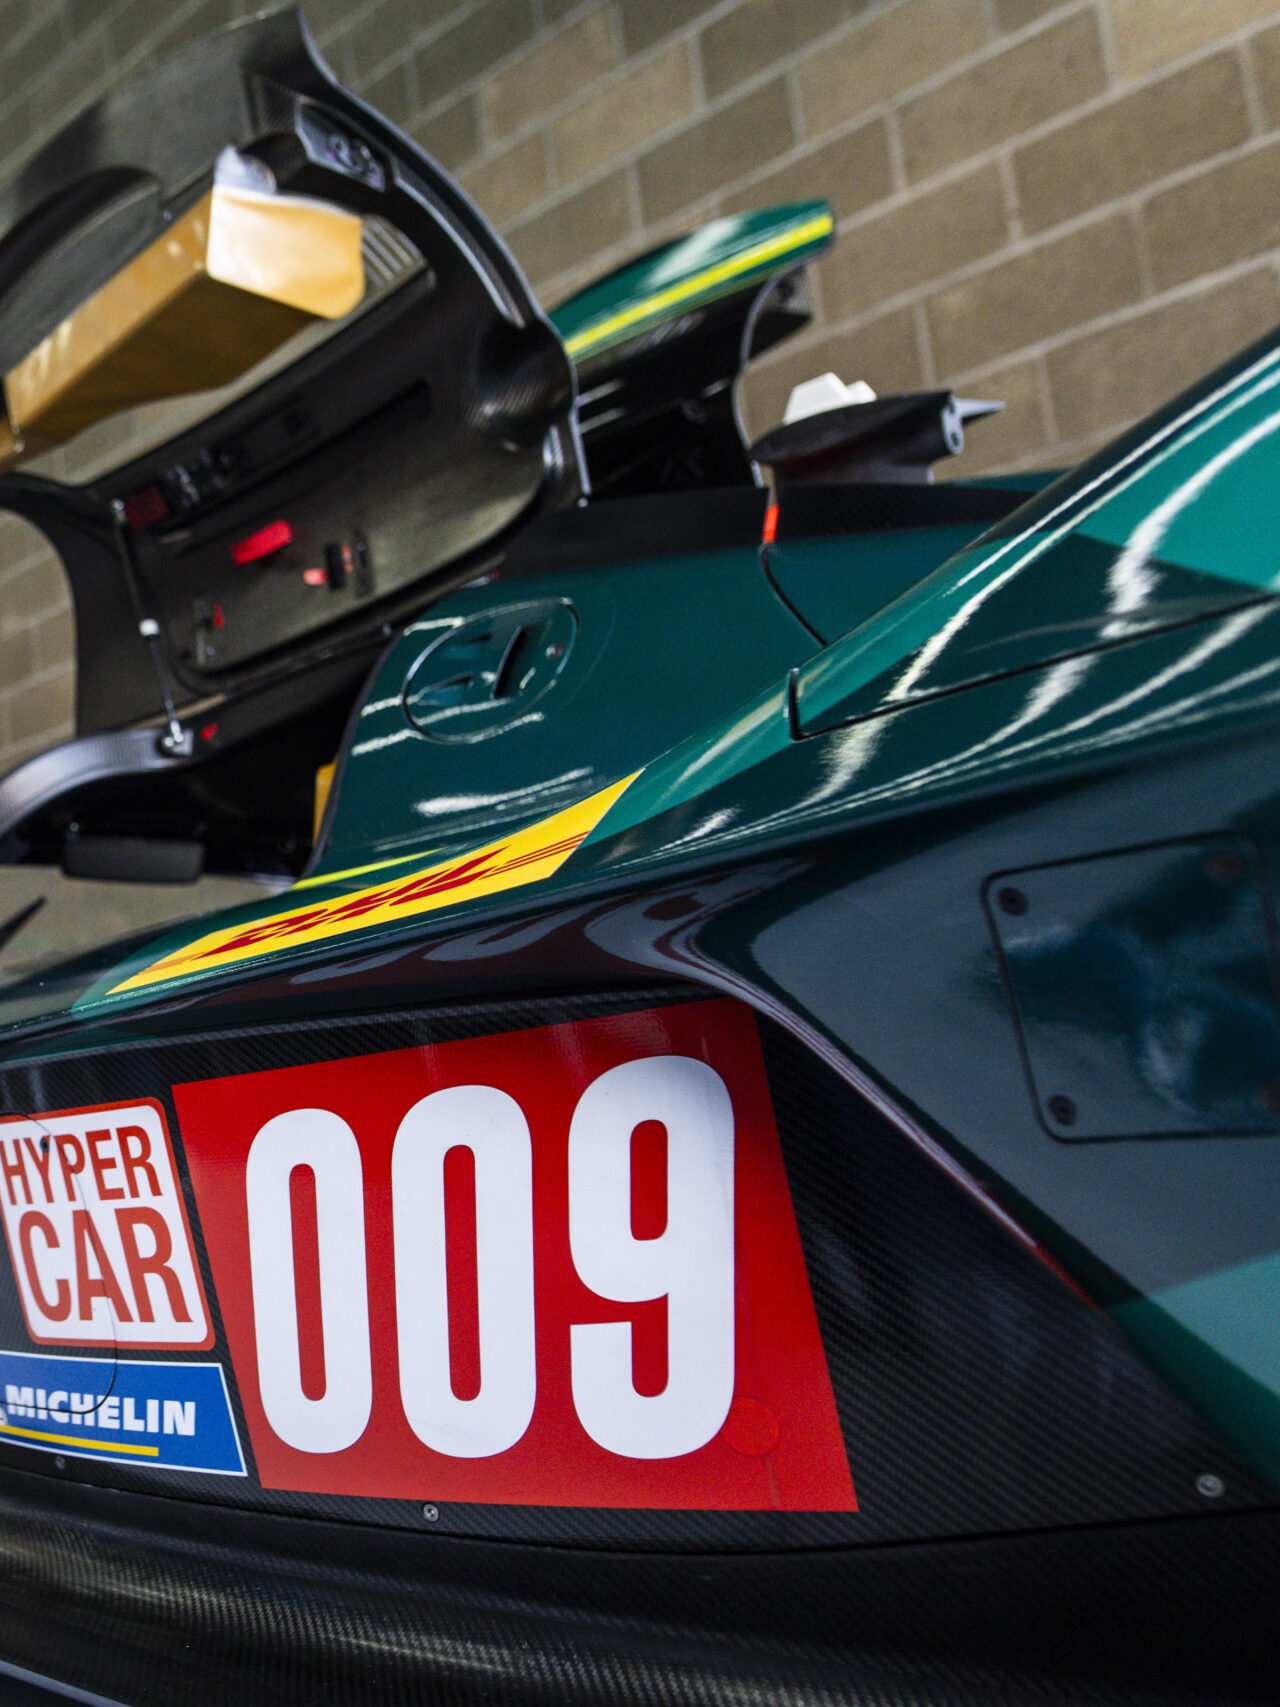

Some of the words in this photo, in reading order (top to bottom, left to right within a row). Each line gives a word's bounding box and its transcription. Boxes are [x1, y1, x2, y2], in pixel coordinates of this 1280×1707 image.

[191, 845, 511, 960] DHL
[18, 1206, 194, 1323] CAR
[245, 1055, 735, 1460] 009
[5, 1384, 196, 1436] MICHELIN
